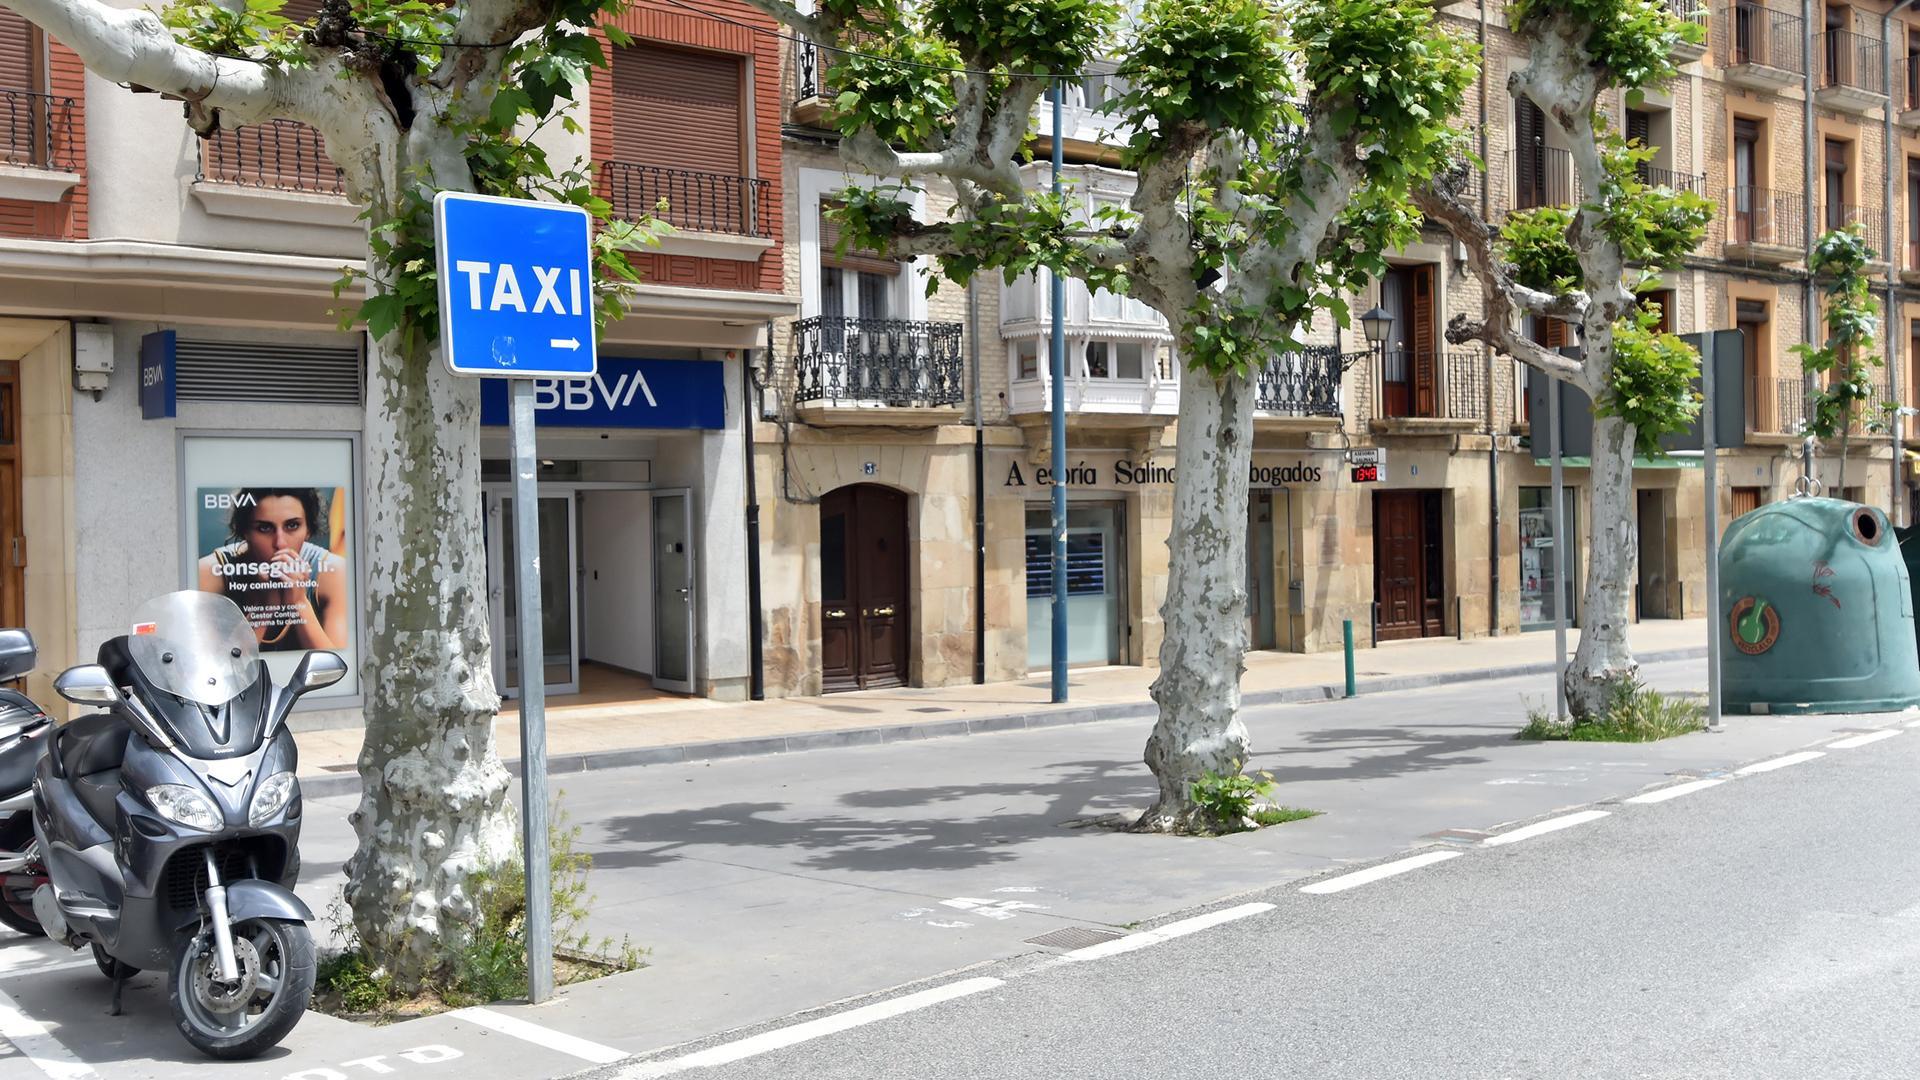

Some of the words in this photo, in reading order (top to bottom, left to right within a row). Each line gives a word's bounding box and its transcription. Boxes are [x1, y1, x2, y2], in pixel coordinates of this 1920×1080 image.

[457, 260, 582, 316] TAXI
[144, 363, 163, 387] BBVA
[533, 370, 657, 411] BBVA
[1250, 454, 1321, 486] bogados
[205, 493, 257, 509] BBVA
[212, 560, 312, 578] conseguir.
[229, 581, 248, 592] Hoy
[250, 579, 294, 590] comienza
[296, 578, 319, 588] todo.
[250, 620, 275, 628] ograma
[274, 611, 300, 619] Contigo
